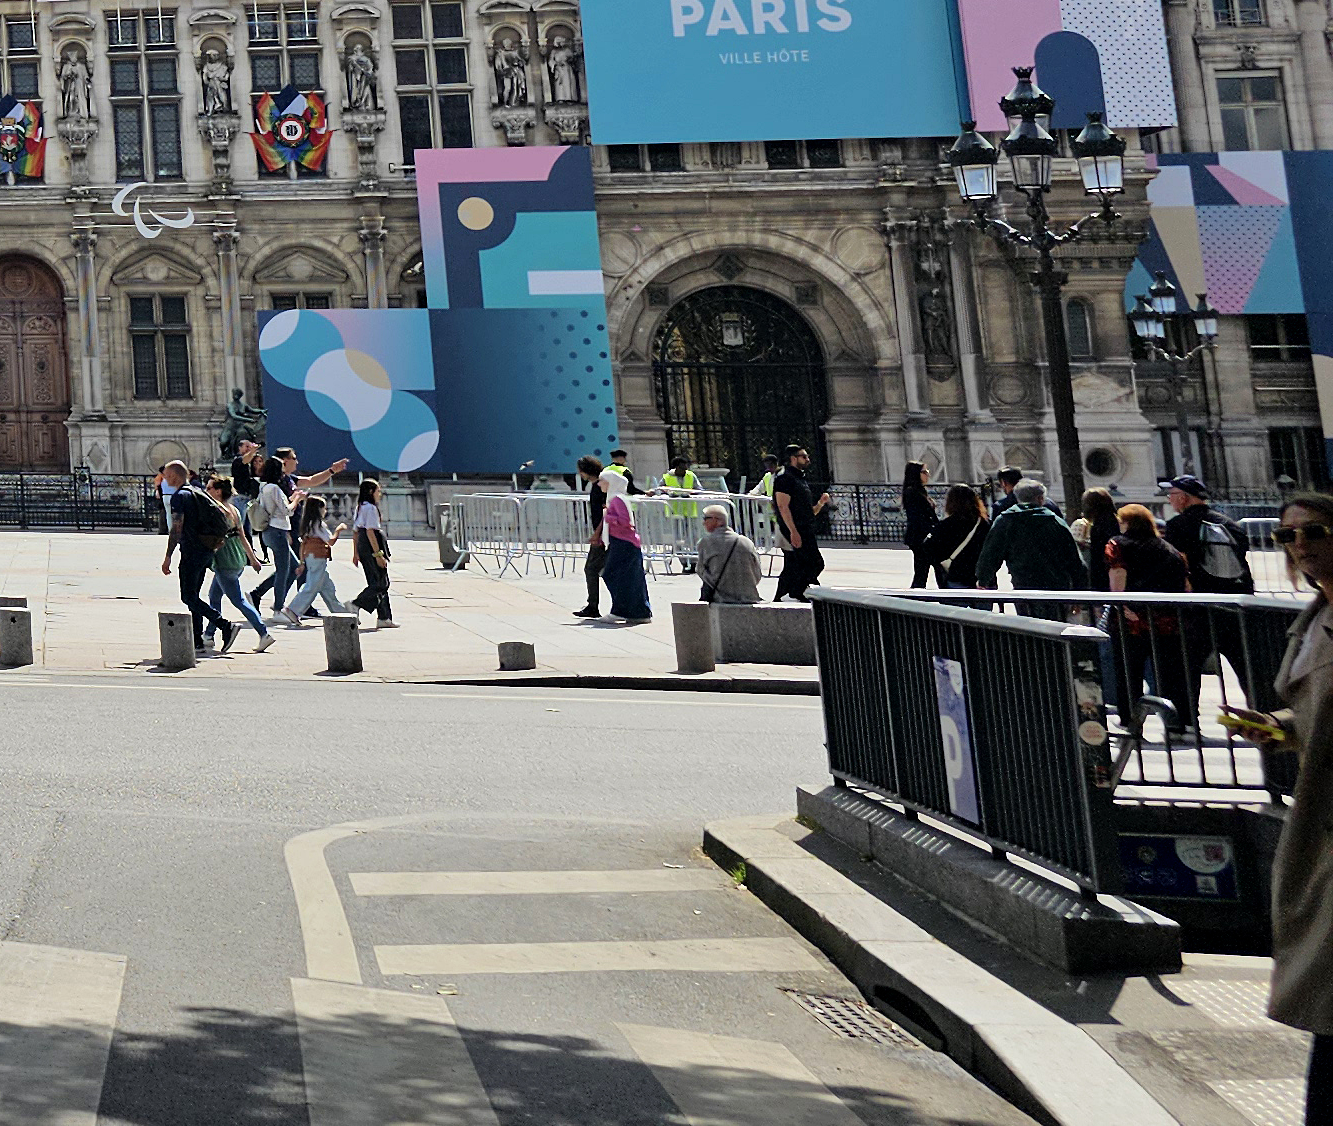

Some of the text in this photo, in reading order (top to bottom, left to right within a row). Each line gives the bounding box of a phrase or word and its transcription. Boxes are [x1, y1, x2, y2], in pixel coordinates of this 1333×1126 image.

[719, 48, 810, 64] VILLE HÔTE
[940, 714, 963, 811] P
